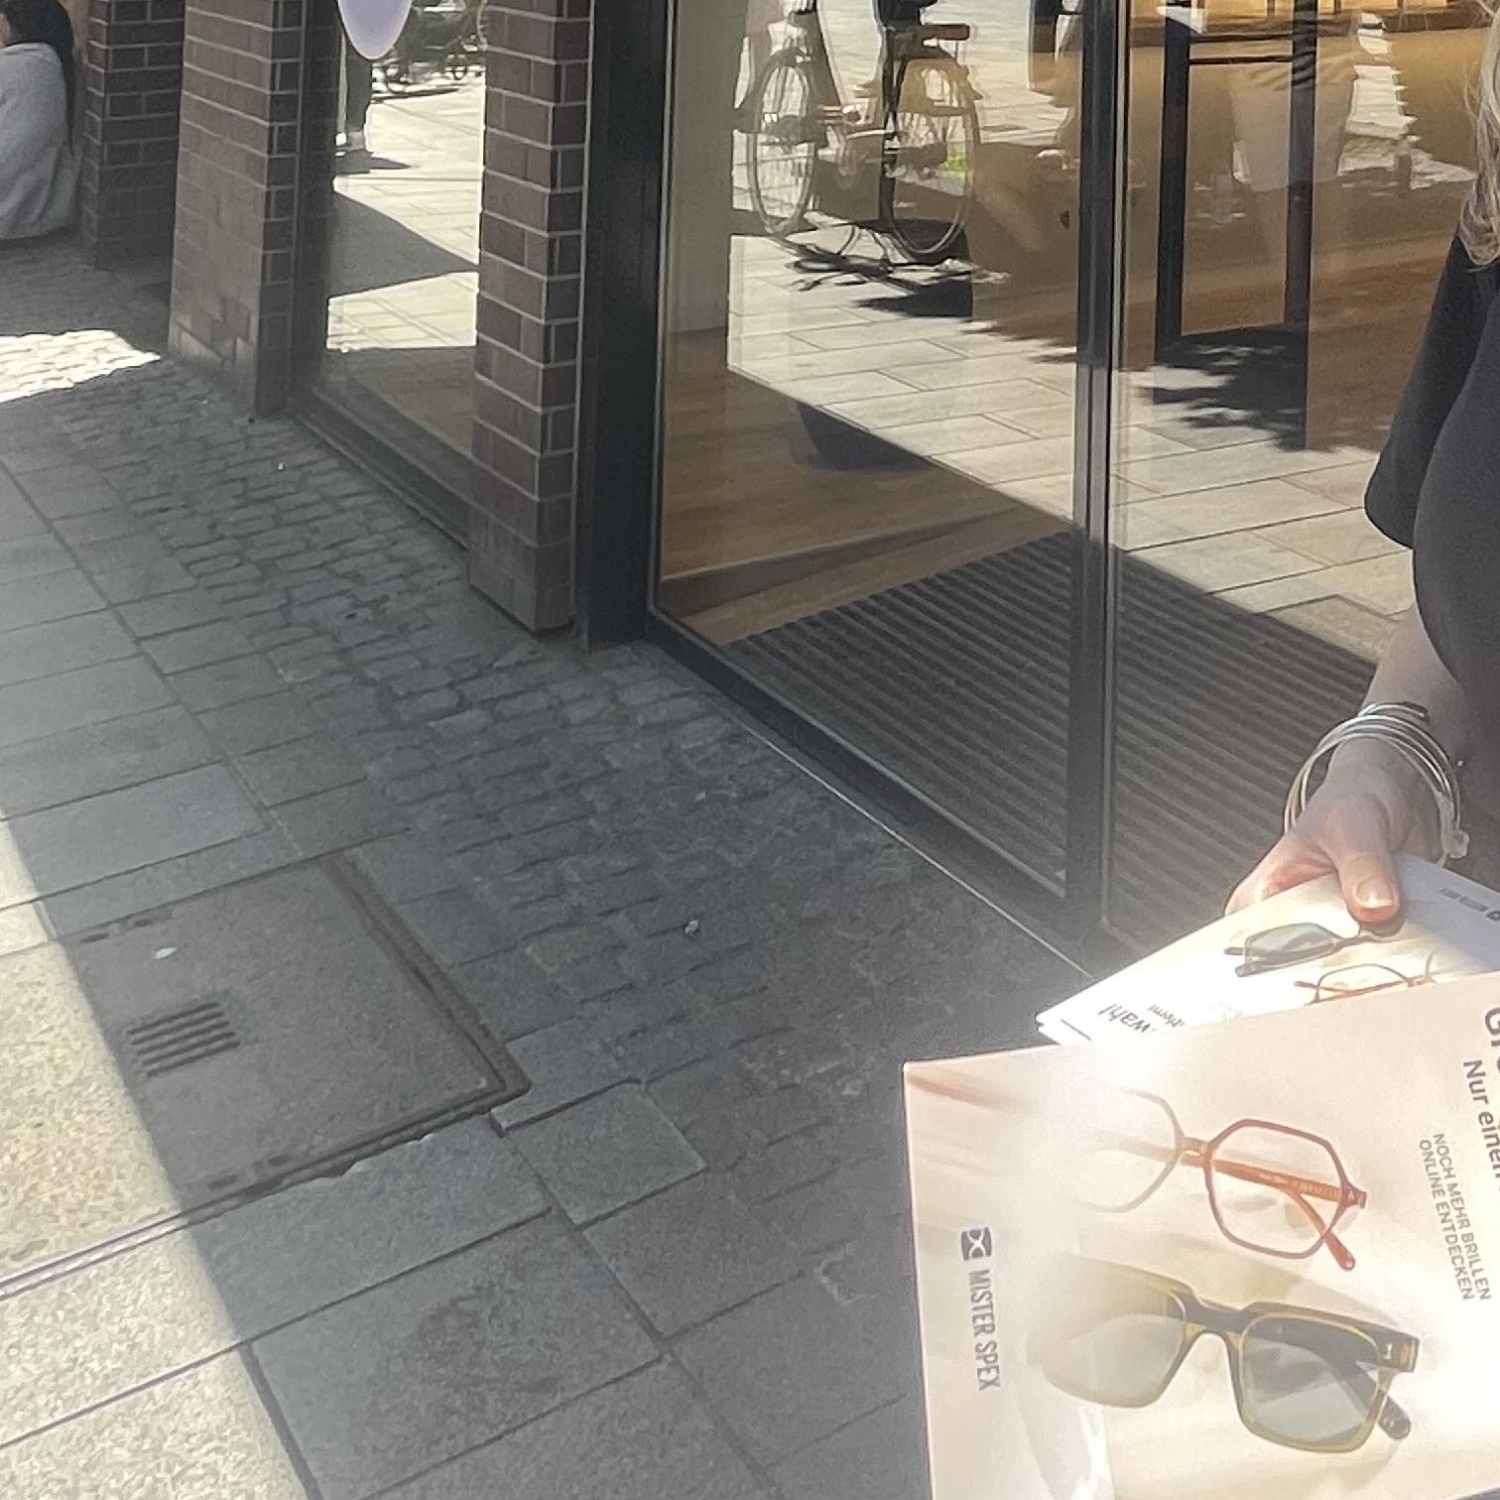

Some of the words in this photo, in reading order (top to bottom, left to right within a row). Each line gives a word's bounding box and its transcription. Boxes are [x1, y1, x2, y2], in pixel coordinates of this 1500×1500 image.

[1463, 1059, 1490, 1105] Nur
[1419, 1139, 1446, 1199] ONLINE
[1435, 1201, 1475, 1300] ENTDECKEN
[1433, 1133, 1456, 1179] NOCH
[1447, 1182, 1471, 1230] MEHR
[1461, 1232, 1492, 1301] BRILLEN
[968, 1269, 996, 1337] MISTER
[975, 1340, 1000, 1391] SPEX
